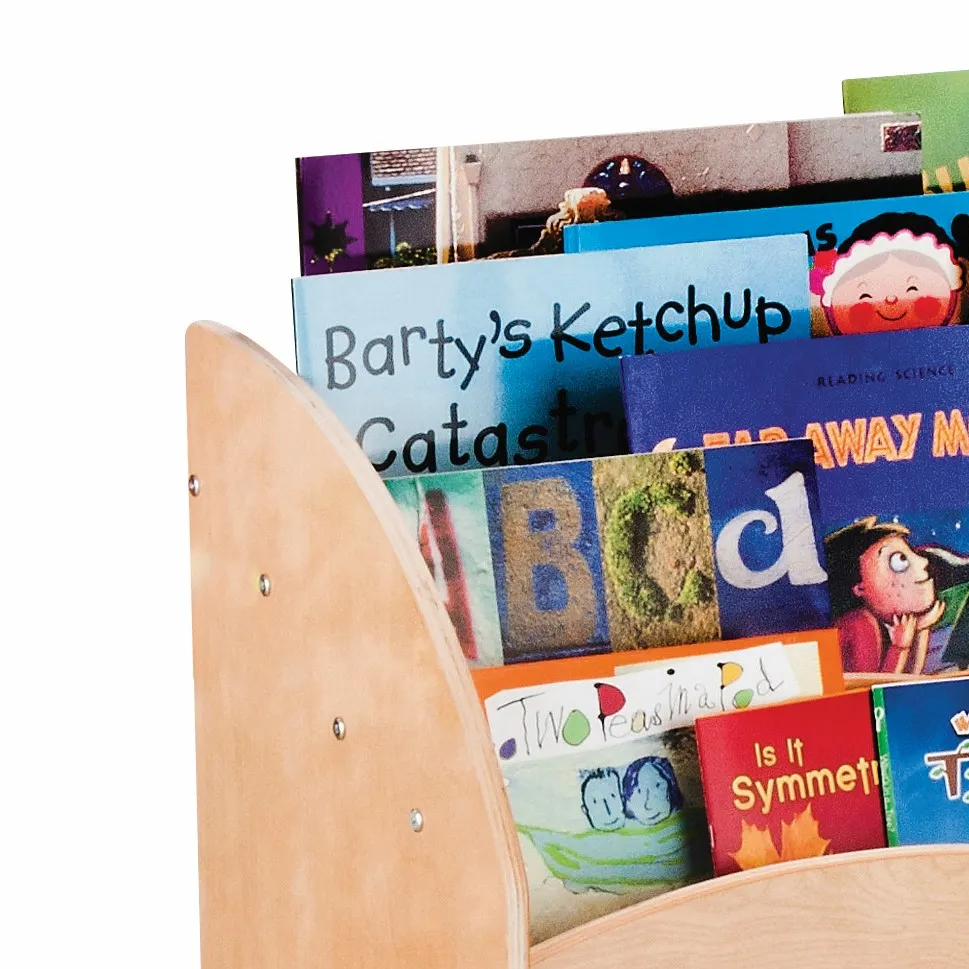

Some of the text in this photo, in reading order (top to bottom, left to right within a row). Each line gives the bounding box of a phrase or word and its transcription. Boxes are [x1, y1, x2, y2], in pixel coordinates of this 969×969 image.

[325, 284, 792, 391] Barty's Ketchup
[817, 365, 956, 388] READING SCIENCE
[356, 389, 629, 473] Catastr
[806, 412, 922, 469] AWAY
[497, 692, 591, 756] Two
[594, 683, 662, 742] Peas
[717, 658, 785, 711] Pod
[754, 738, 804, 767] Is It
